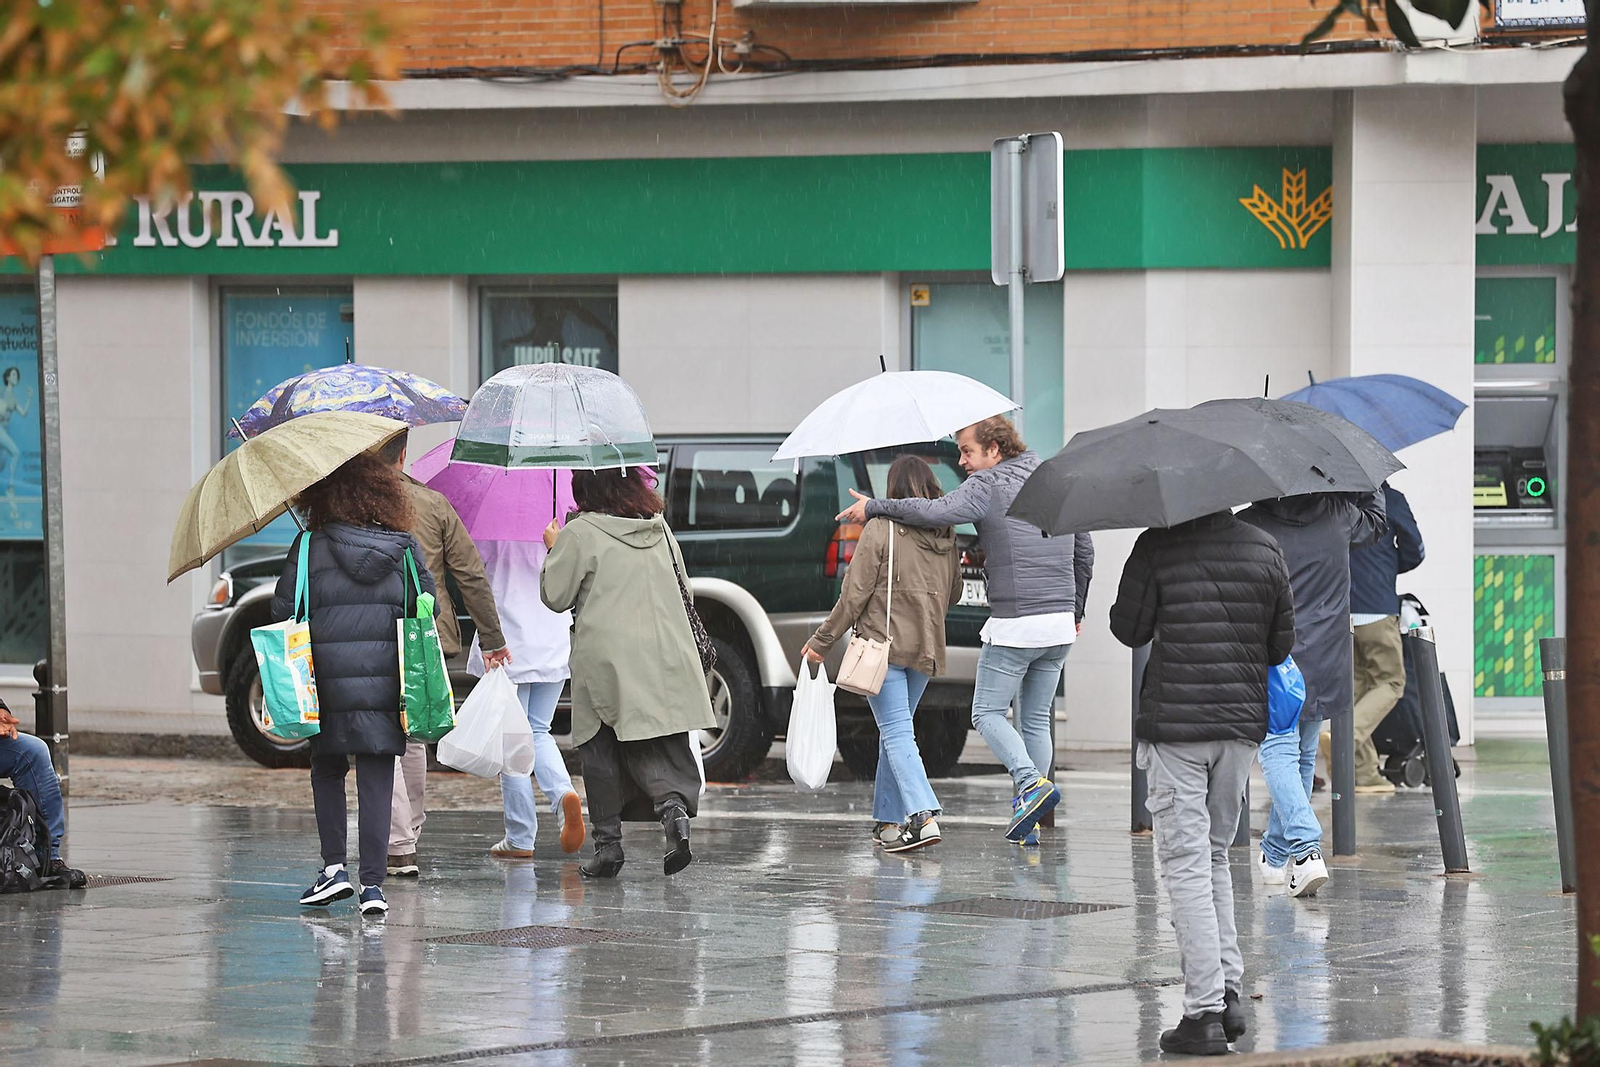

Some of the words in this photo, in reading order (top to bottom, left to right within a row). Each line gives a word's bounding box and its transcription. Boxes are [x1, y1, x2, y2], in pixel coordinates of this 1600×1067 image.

[133, 190, 339, 248] RURAL
[1476, 173, 1578, 238] AJ
[235, 311, 302, 329] FONDOS
[306, 311, 327, 329] DE
